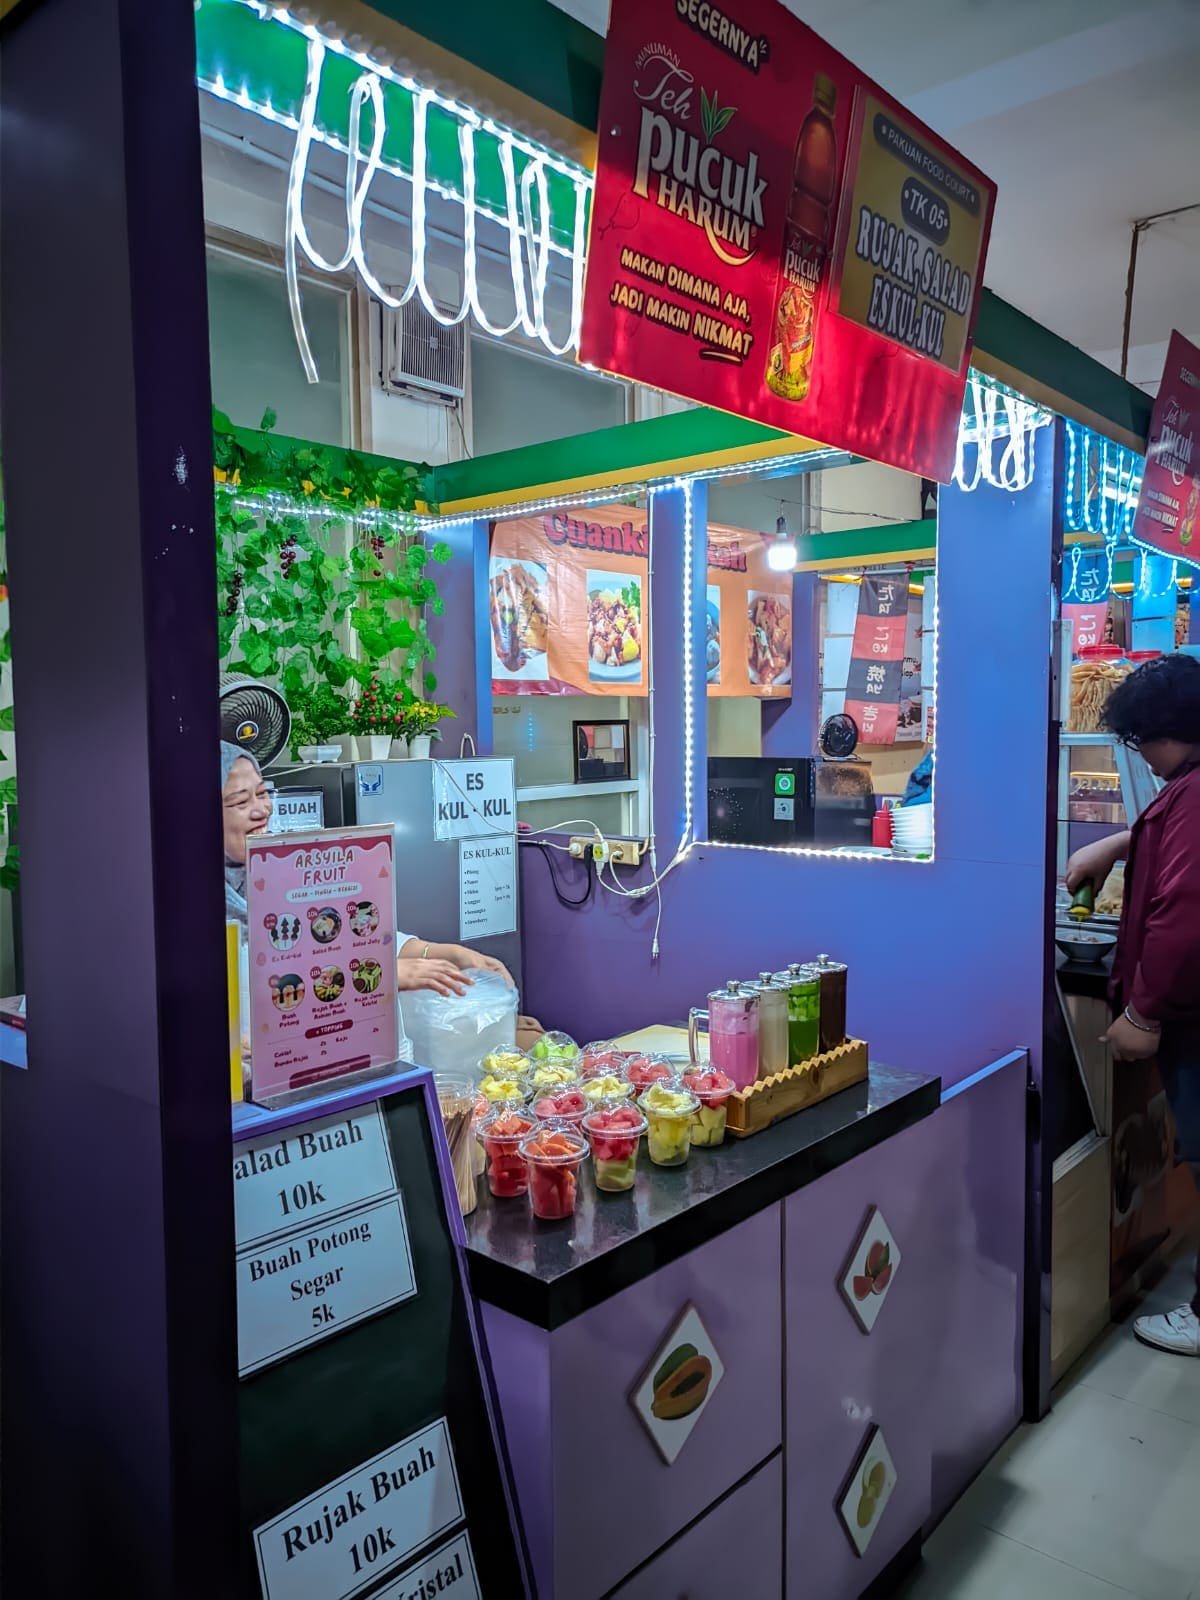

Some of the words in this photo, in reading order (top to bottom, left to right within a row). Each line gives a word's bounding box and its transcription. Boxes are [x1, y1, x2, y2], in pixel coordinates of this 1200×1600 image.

[634, 42, 680, 70] MINUMAN
[632, 54, 694, 120] Teh
[633, 106, 768, 228] pucuk
[888, 128, 921, 164] PAKUAN
[922, 156, 944, 181] FOOD
[657, 172, 756, 264] HARUM
[910, 188, 928, 220] TK
[929, 204, 945, 230] 05
[621, 248, 666, 281] MAKAN
[667, 266, 721, 307] DIMANA
[723, 293, 751, 322] AJA,
[611, 283, 644, 312] JADI
[646, 297, 690, 330] MAKIN
[693, 313, 753, 356] NIKMAT
[466, 772, 483, 791] ES
[278, 802, 316, 816] BUAH
[438, 801, 469, 820] KUL
[483, 798, 512, 817] KUL
[295, 850, 353, 868] ARSYILA
[463, 850, 474, 859] ES
[475, 847, 511, 858] KUL-KUL
[303, 867, 346, 885] FRUIT
[234, 1141, 291, 1179] alad
[296, 1120, 364, 1159] Buah
[277, 1180, 326, 1217] 10k
[249, 1246, 302, 1282] Buah
[307, 1222, 372, 1259] Potong
[290, 1264, 344, 1301] Segar
[311, 1303, 336, 1328] 5k
[280, 1493, 367, 1562] Rujak
[369, 1445, 436, 1505] Buah
[348, 1524, 397, 1575] 10k
[397, 1553, 464, 1600] ristal
